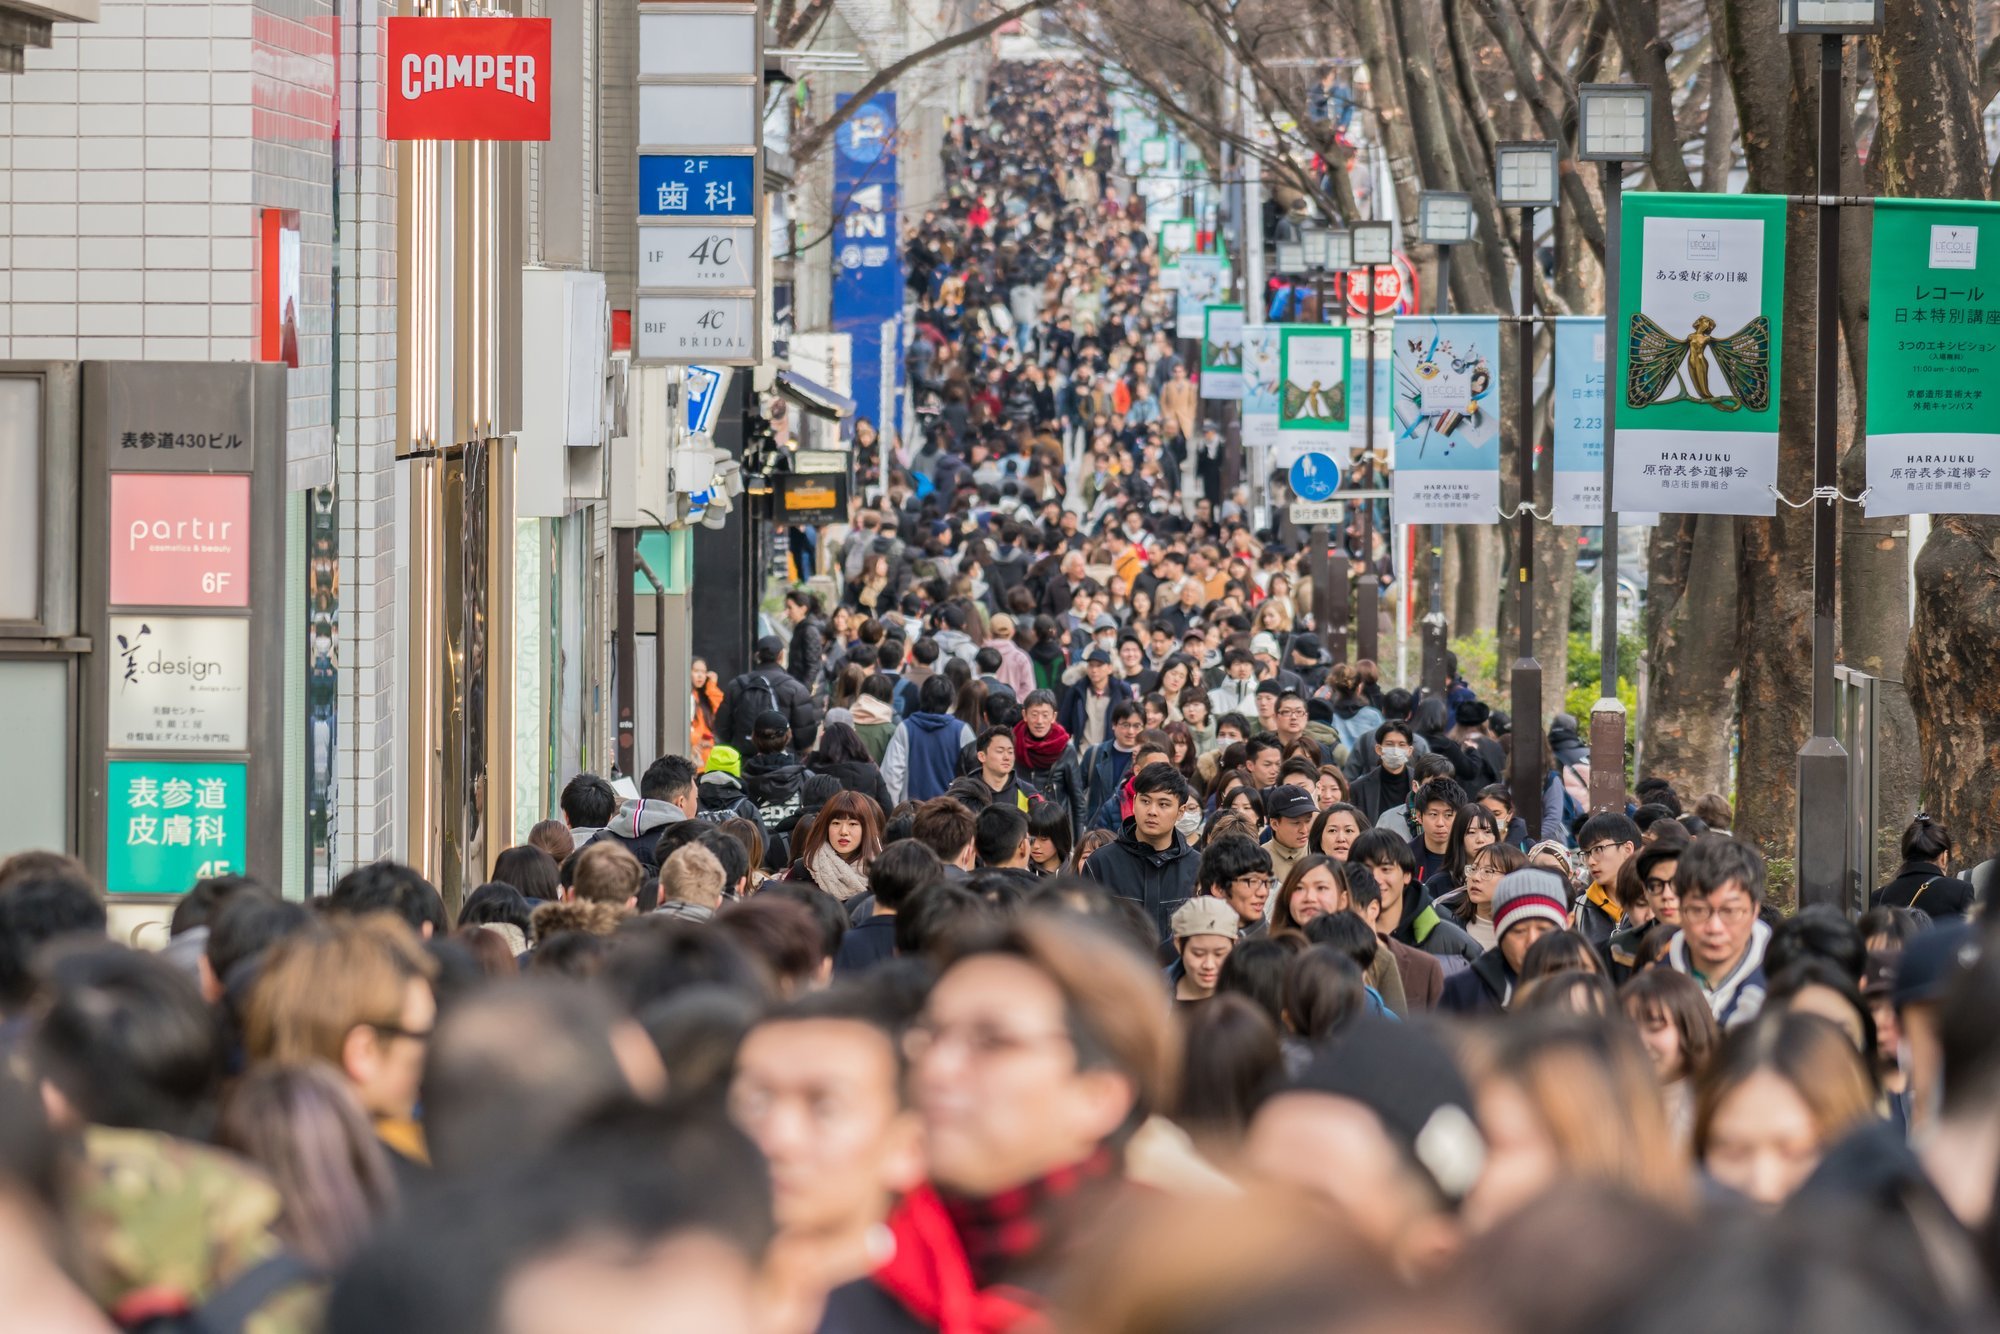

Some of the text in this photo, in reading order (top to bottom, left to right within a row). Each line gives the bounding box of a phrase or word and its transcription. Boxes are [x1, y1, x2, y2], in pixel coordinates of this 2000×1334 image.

[401, 53, 536, 103] CAMPER
[684, 159, 709, 173] 2F
[657, 181, 736, 211] 歯科
[845, 212, 886, 238] IN
[648, 251, 664, 263] 1F
[1656, 270, 1749, 283] ある愛好家の目線
[1916, 285, 1984, 302] レコール
[1895, 307, 2000, 325] 日本特別講座
[679, 336, 745, 348] BRIDAL
[1898, 341, 1997, 353] 3つのエキシビション
[1913, 402, 1974, 411] 外苑キャンパス
[121, 432, 243, 450] 表参道430ビル
[1661, 452, 1732, 462] HARAJUKU
[1906, 455, 1975, 463] HARAJUKU
[130, 517, 232, 551] partir
[149, 544, 192, 552] cosmetics
[201, 543, 232, 554] beauty
[202, 572, 232, 593] 6F
[127, 776, 227, 809] 表参道
[126, 813, 227, 847] 皮膚科
